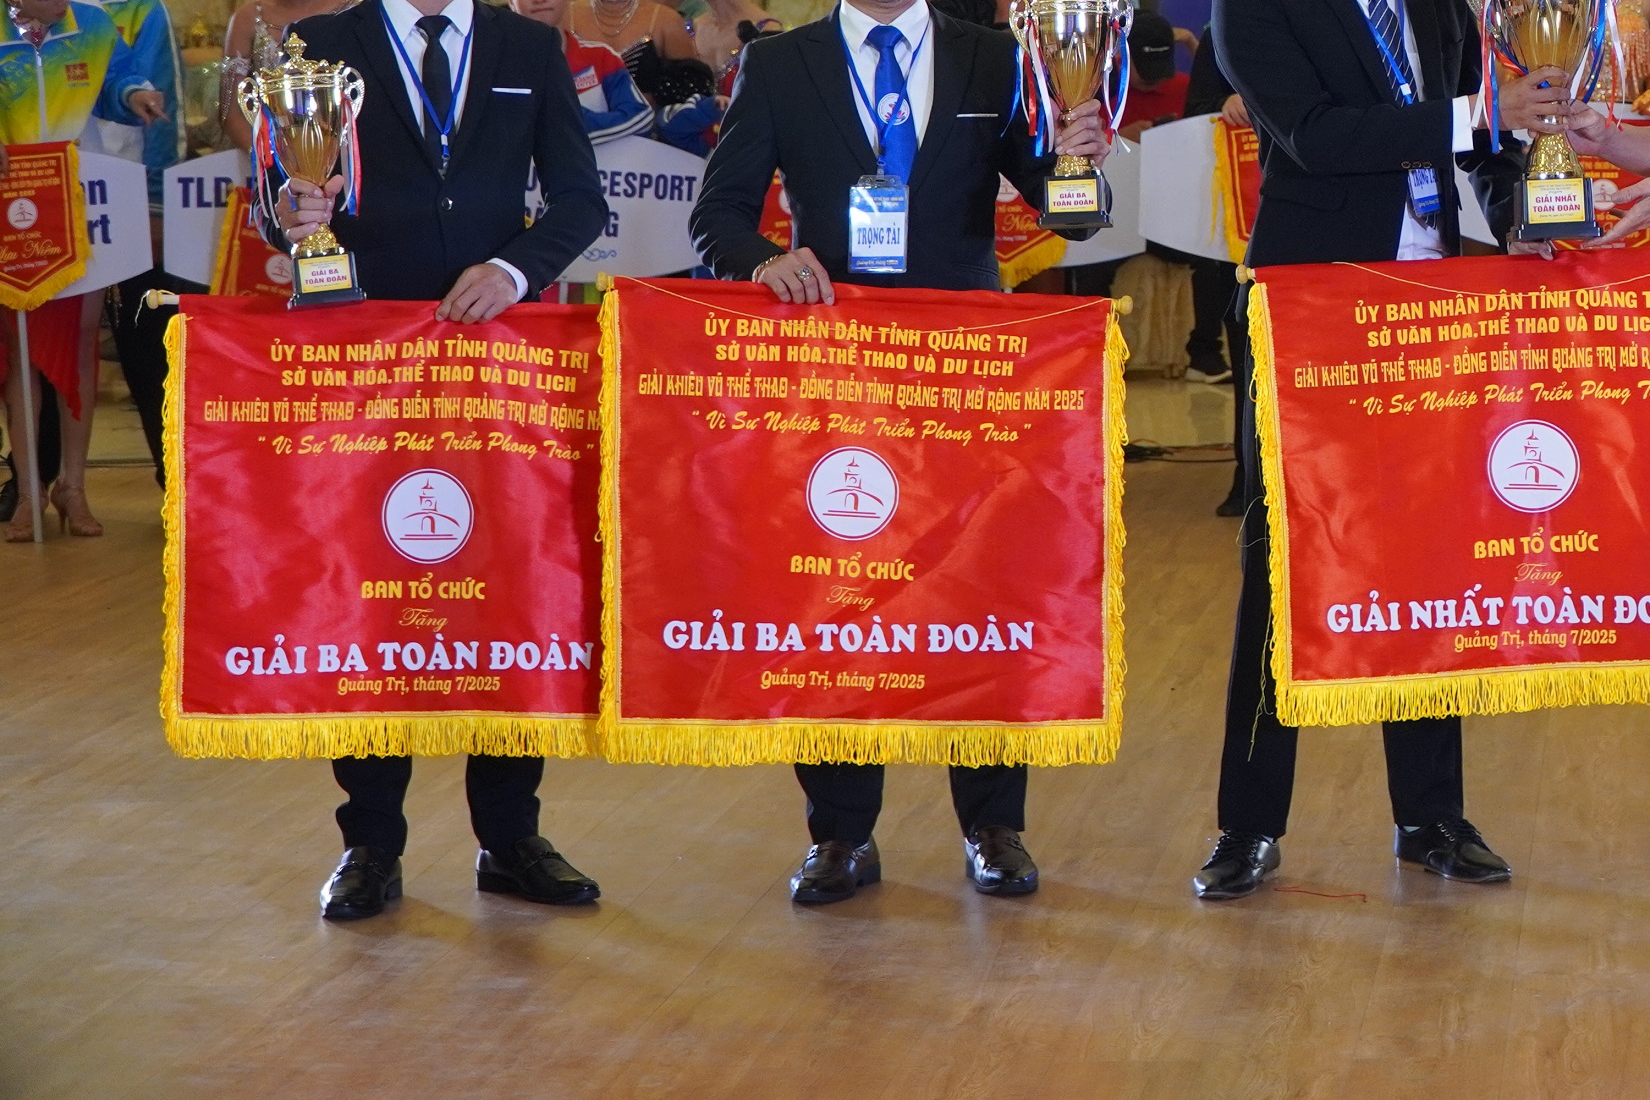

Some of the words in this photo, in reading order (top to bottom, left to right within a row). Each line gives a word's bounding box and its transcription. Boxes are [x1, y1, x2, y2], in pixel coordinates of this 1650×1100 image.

[599, 170, 697, 201] CESPORT
[858, 228, 884, 248] TRỌNG
[886, 222, 900, 244] TÀI
[1355, 300, 1383, 324] ỦY
[1386, 304, 1425, 321] BAN
[1429, 291, 1479, 318] NHÂN
[1485, 288, 1523, 312] DÂN
[1528, 285, 1570, 310] TỈNH
[1575, 285, 1637, 309] QUẢNG
[1367, 326, 1392, 347] SỞ
[1396, 322, 1432, 344] VĂN
[1515, 317, 1561, 333] THAO
[1565, 311, 1588, 331] VÀ
[1594, 315, 1617, 331] DU
[1295, 362, 1319, 388] GIẢI
[1322, 360, 1358, 386] KHIÊU
[1361, 359, 1378, 384] VŨ
[1381, 352, 1405, 381] THỂ
[1408, 357, 1442, 379] THAO
[1453, 343, 1487, 375] ĐỒNG
[1490, 342, 1518, 371] DIỄN
[1521, 342, 1548, 371] TỈNH
[1552, 344, 1592, 372] QUẢNG
[1596, 346, 1617, 372] TRỊ
[1619, 340, 1639, 367] MỞ
[1363, 398, 1383, 415] Vì
[1388, 394, 1416, 417] Sự
[1420, 390, 1479, 413] Nghiệp
[1484, 383, 1523, 404] Phát
[1529, 380, 1574, 403] Triển
[1581, 380, 1632, 403] Phong
[1474, 538, 1516, 559] BAN
[1520, 526, 1544, 553] TỔ
[1549, 531, 1599, 553] CHỨC
[790, 555, 832, 576] BAN
[836, 551, 862, 579] TỔ
[866, 557, 915, 581] CHỨC
[1513, 562, 1564, 585] Tặng
[361, 580, 403, 599] BAN
[409, 572, 434, 599] TỔ
[438, 576, 486, 600] CHỨC
[1326, 590, 1401, 634] GIẢI
[1410, 583, 1505, 631] NHẤT
[1513, 587, 1605, 627] TOÀN
[663, 609, 745, 652] GIẢI
[755, 621, 807, 652] BA
[814, 614, 917, 653] TOÀN
[927, 614, 1035, 652] ĐOÀN
[1454, 631, 1499, 653] Quảng
[1501, 628, 1525, 649] Trị,
[1528, 628, 1567, 649] tháng
[1571, 627, 1617, 647] 7/2025
[225, 634, 308, 676] GIẢI
[317, 643, 369, 673] BA
[377, 633, 479, 672] TOÀN
[489, 632, 594, 671] ĐOÀN
